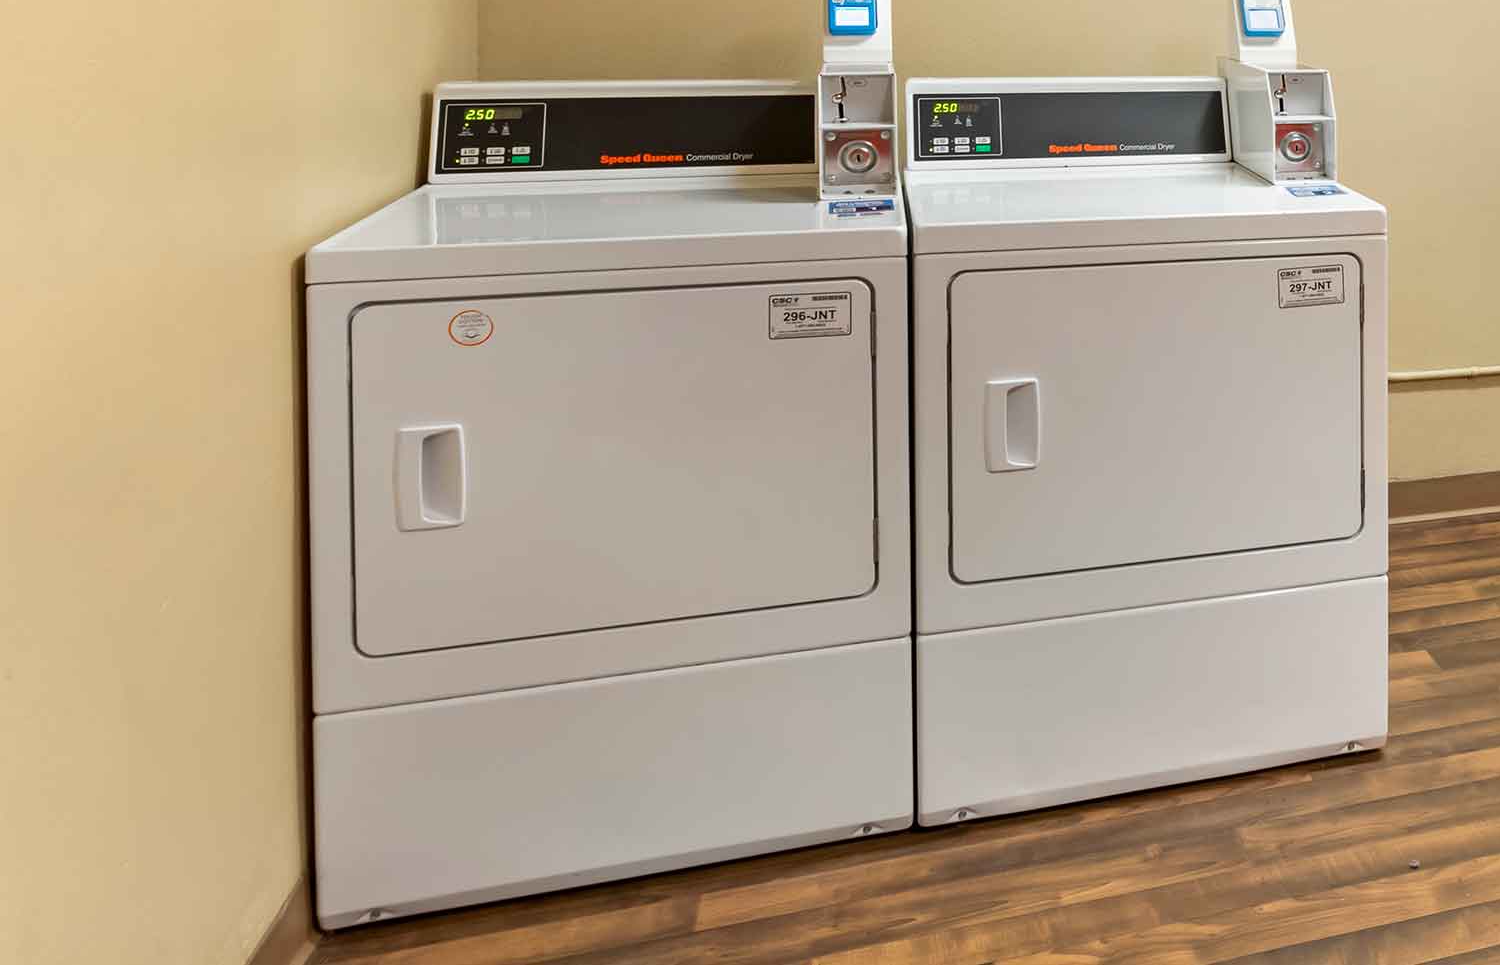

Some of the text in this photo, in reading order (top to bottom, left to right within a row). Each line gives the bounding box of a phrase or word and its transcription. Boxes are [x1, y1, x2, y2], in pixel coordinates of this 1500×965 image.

[933, 102, 958, 113] 2.50
[465, 109, 495, 121] 2.50
[1048, 142, 1176, 154] Speed Queen Commercial Dryer
[600, 152, 753, 165] Speed Queen Commercial Dryer
[1289, 280, 1332, 293] 297-JNT
[783, 309, 837, 322] 296-JNT
